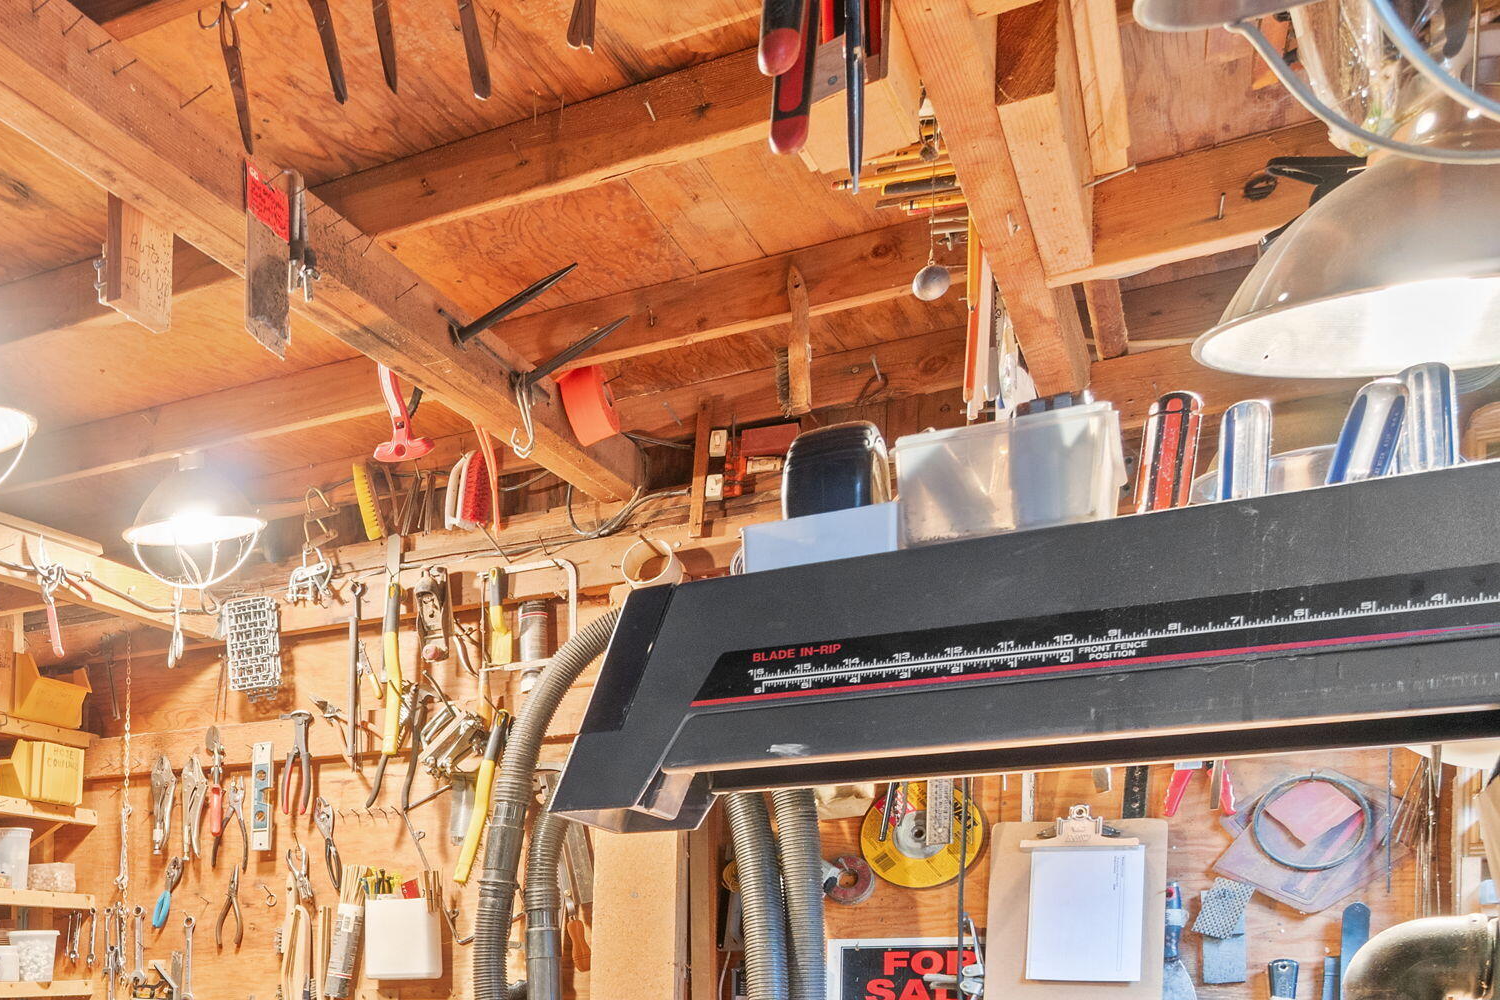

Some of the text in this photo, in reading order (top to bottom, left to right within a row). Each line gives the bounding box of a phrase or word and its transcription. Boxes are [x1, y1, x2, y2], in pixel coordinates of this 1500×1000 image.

[752, 643, 842, 663] BLADE IN-RIP
[1078, 640, 1148, 655] FRONT FENCE
[1088, 648, 1137, 661] POSITION
